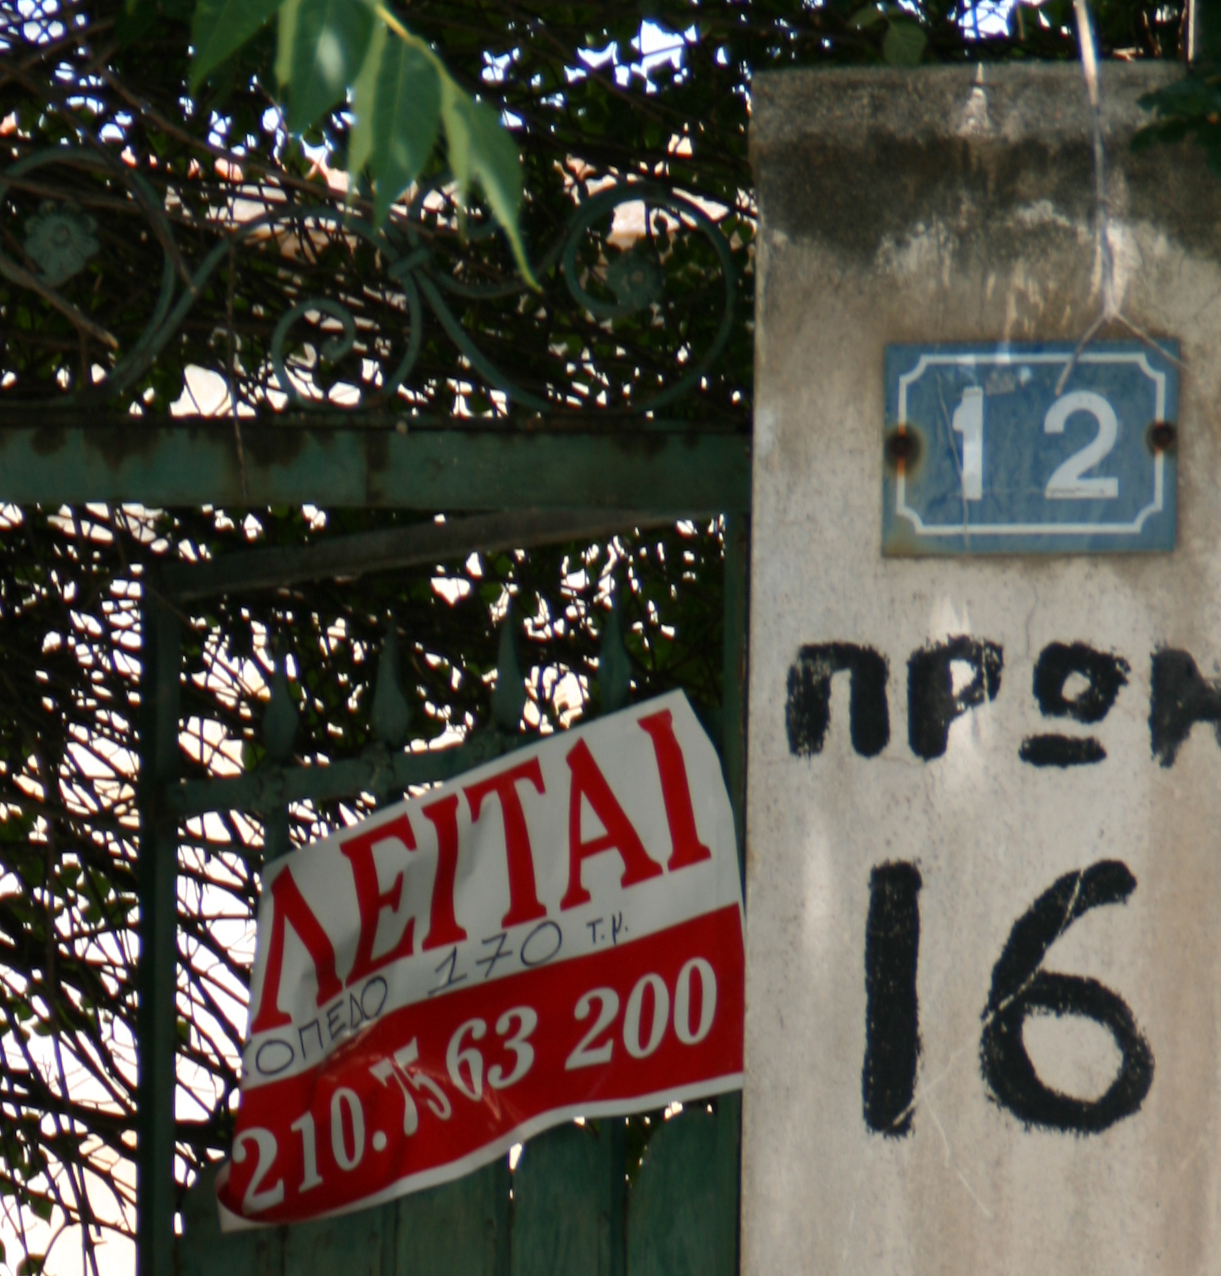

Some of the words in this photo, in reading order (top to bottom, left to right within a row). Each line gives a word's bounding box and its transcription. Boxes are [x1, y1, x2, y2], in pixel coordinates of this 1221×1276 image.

[951, 384, 1119, 500] 12
[427, 921, 563, 996] 170
[565, 956, 718, 1071] 200
[860, 859, 1155, 1138] 16
